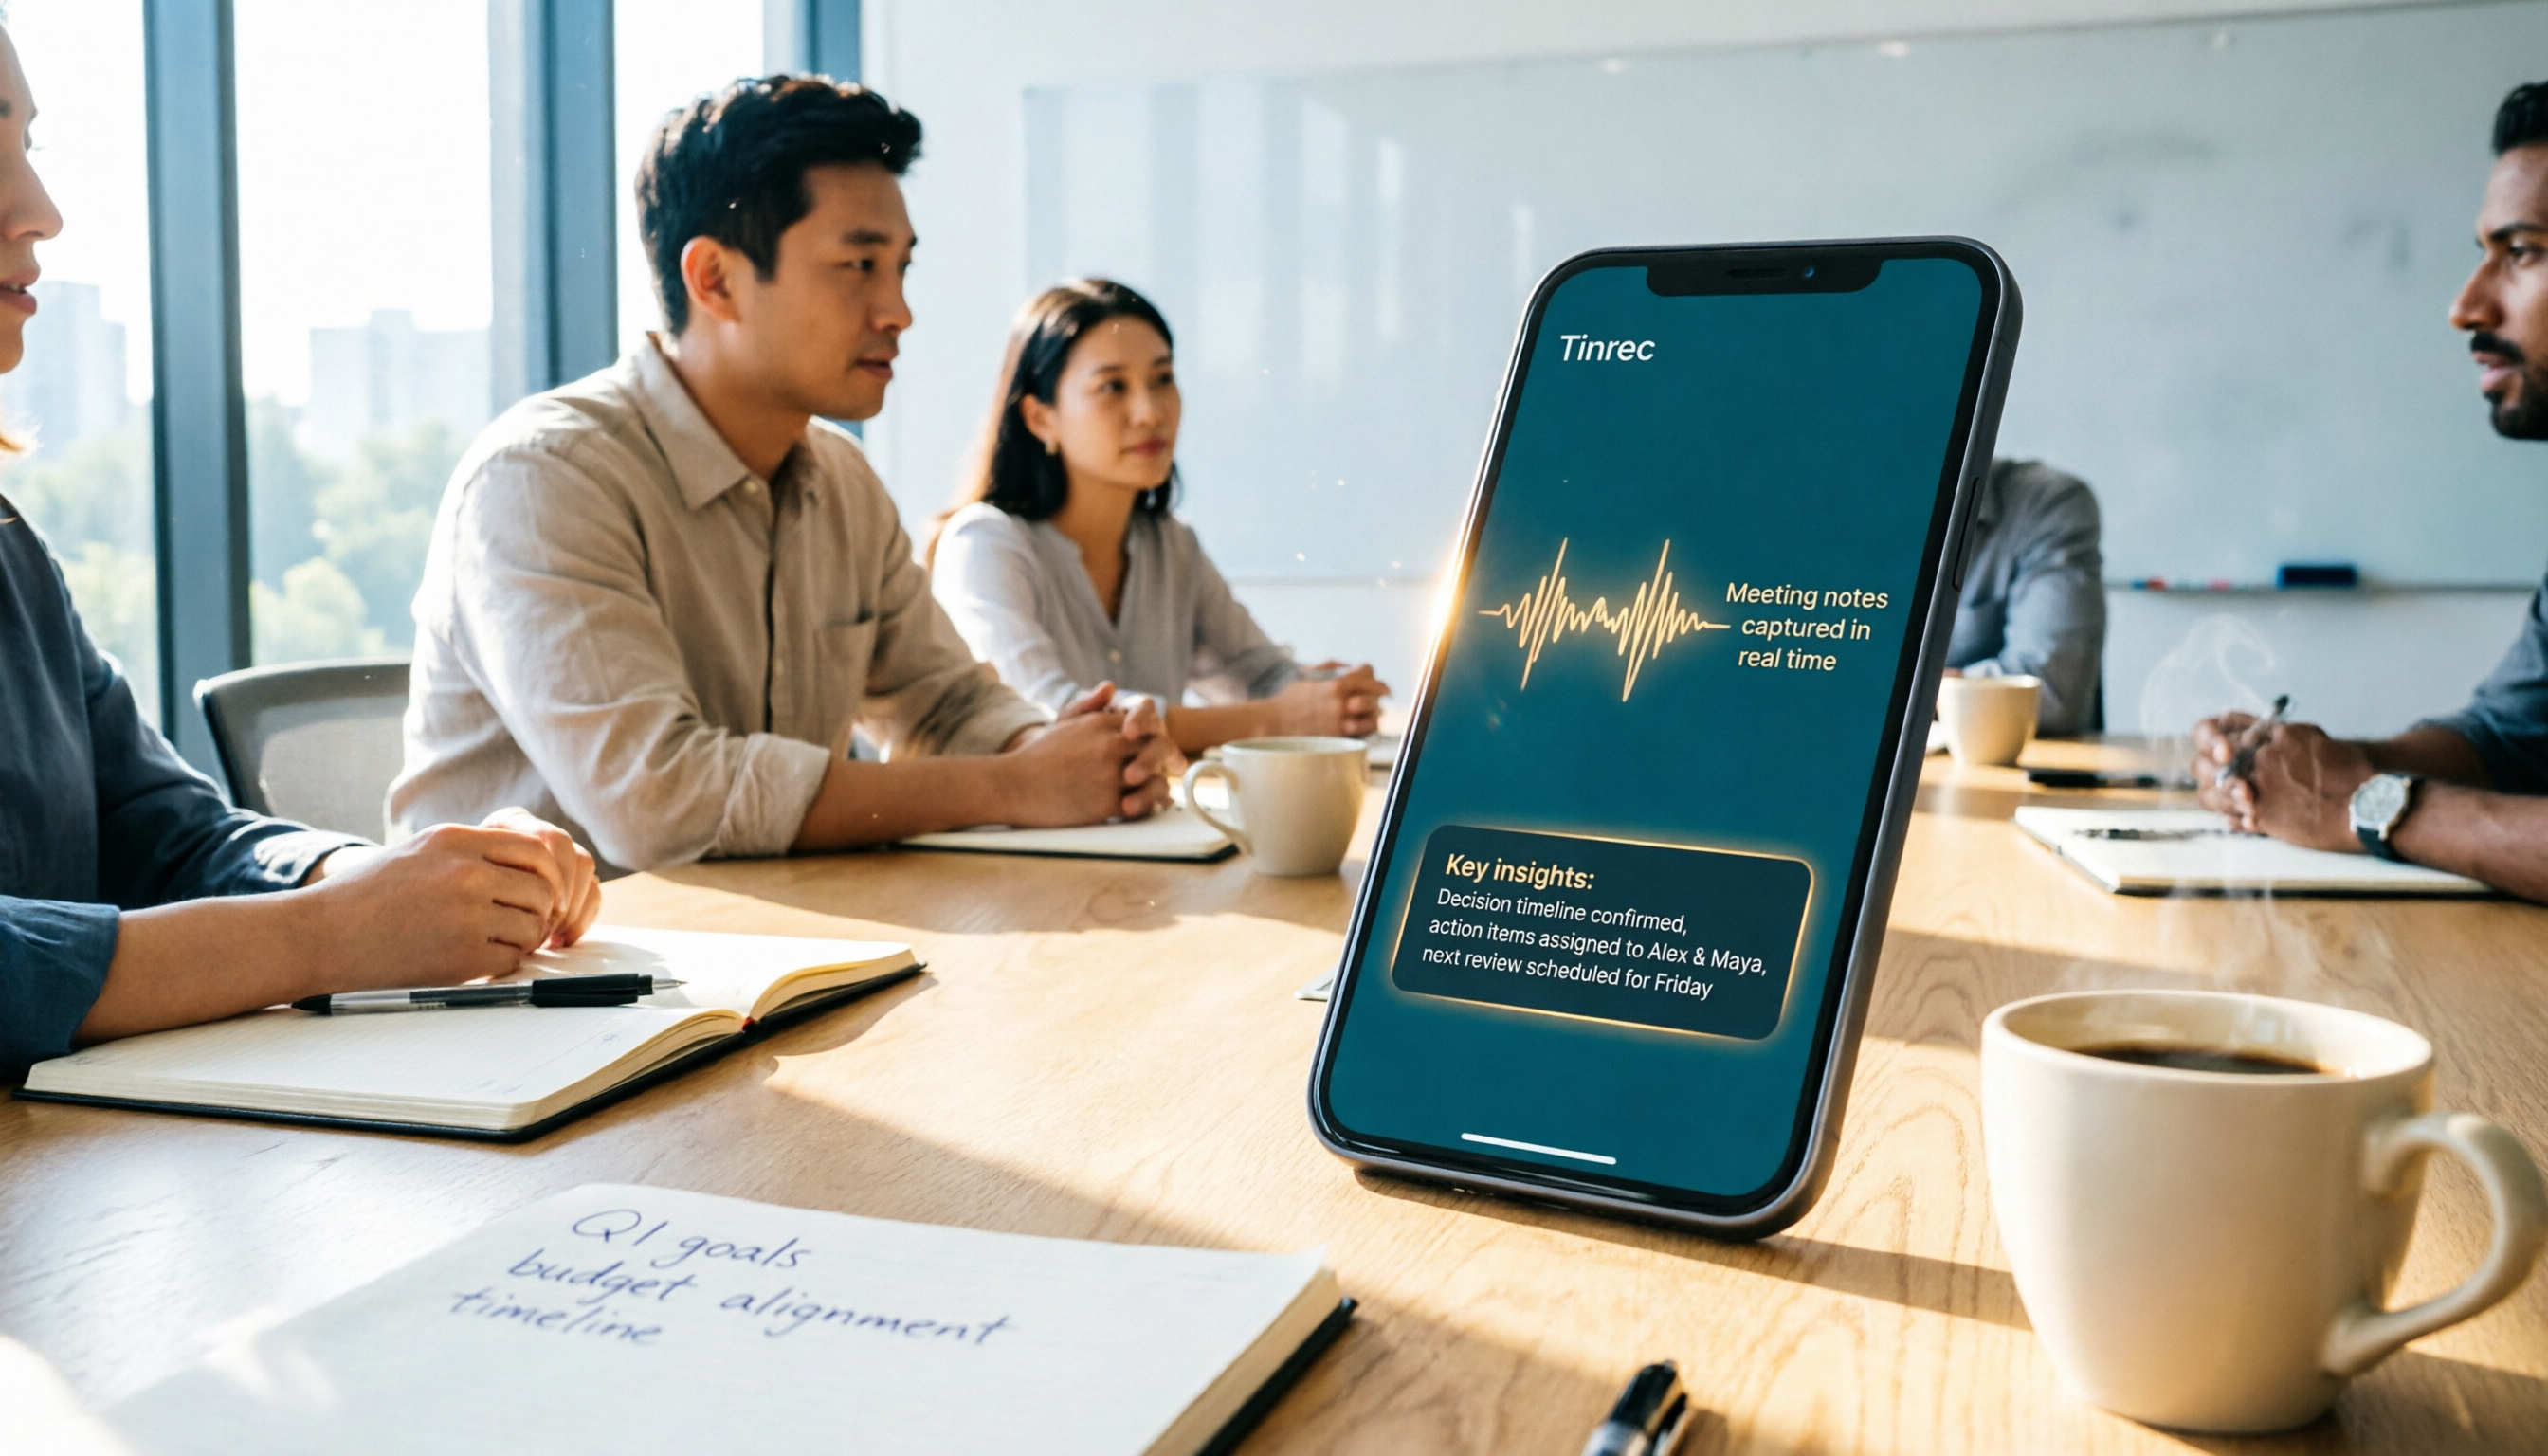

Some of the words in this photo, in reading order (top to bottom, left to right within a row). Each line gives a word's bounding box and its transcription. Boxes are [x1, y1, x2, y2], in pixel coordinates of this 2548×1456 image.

[1560, 334, 1656, 361] Tinrec
[1726, 582, 1819, 610] Meeting
[1823, 588, 1888, 609] notes
[1741, 618, 1846, 642] captured
[1850, 618, 1871, 640] in
[1738, 647, 1782, 668] real
[1786, 647, 1837, 671] time
[1445, 853, 1490, 883] Key
[1493, 857, 1595, 891] insights:
[1437, 887, 1512, 913] Decision
[1516, 896, 1587, 921] timeline
[1590, 907, 1687, 937] confirmed,
[1429, 918, 1483, 939] action
[1486, 921, 1536, 945] items
[1538, 932, 1622, 956] assigned
[1626, 939, 1644, 958] to
[1647, 941, 1689, 964] Alex
[1692, 946, 1706, 967] &
[1710, 948, 1767, 977] Maya,
[1422, 948, 1462, 966] next
[1464, 952, 1523, 974] review
[1525, 958, 1621, 986] scheduled
[1625, 968, 1652, 989] for
[1654, 973, 1714, 1002] Friday
[650, 1236, 813, 1268] goals
[508, 1247, 699, 1305] budget
[719, 1287, 1014, 1344] alignment
[449, 1285, 663, 1346] timeline
